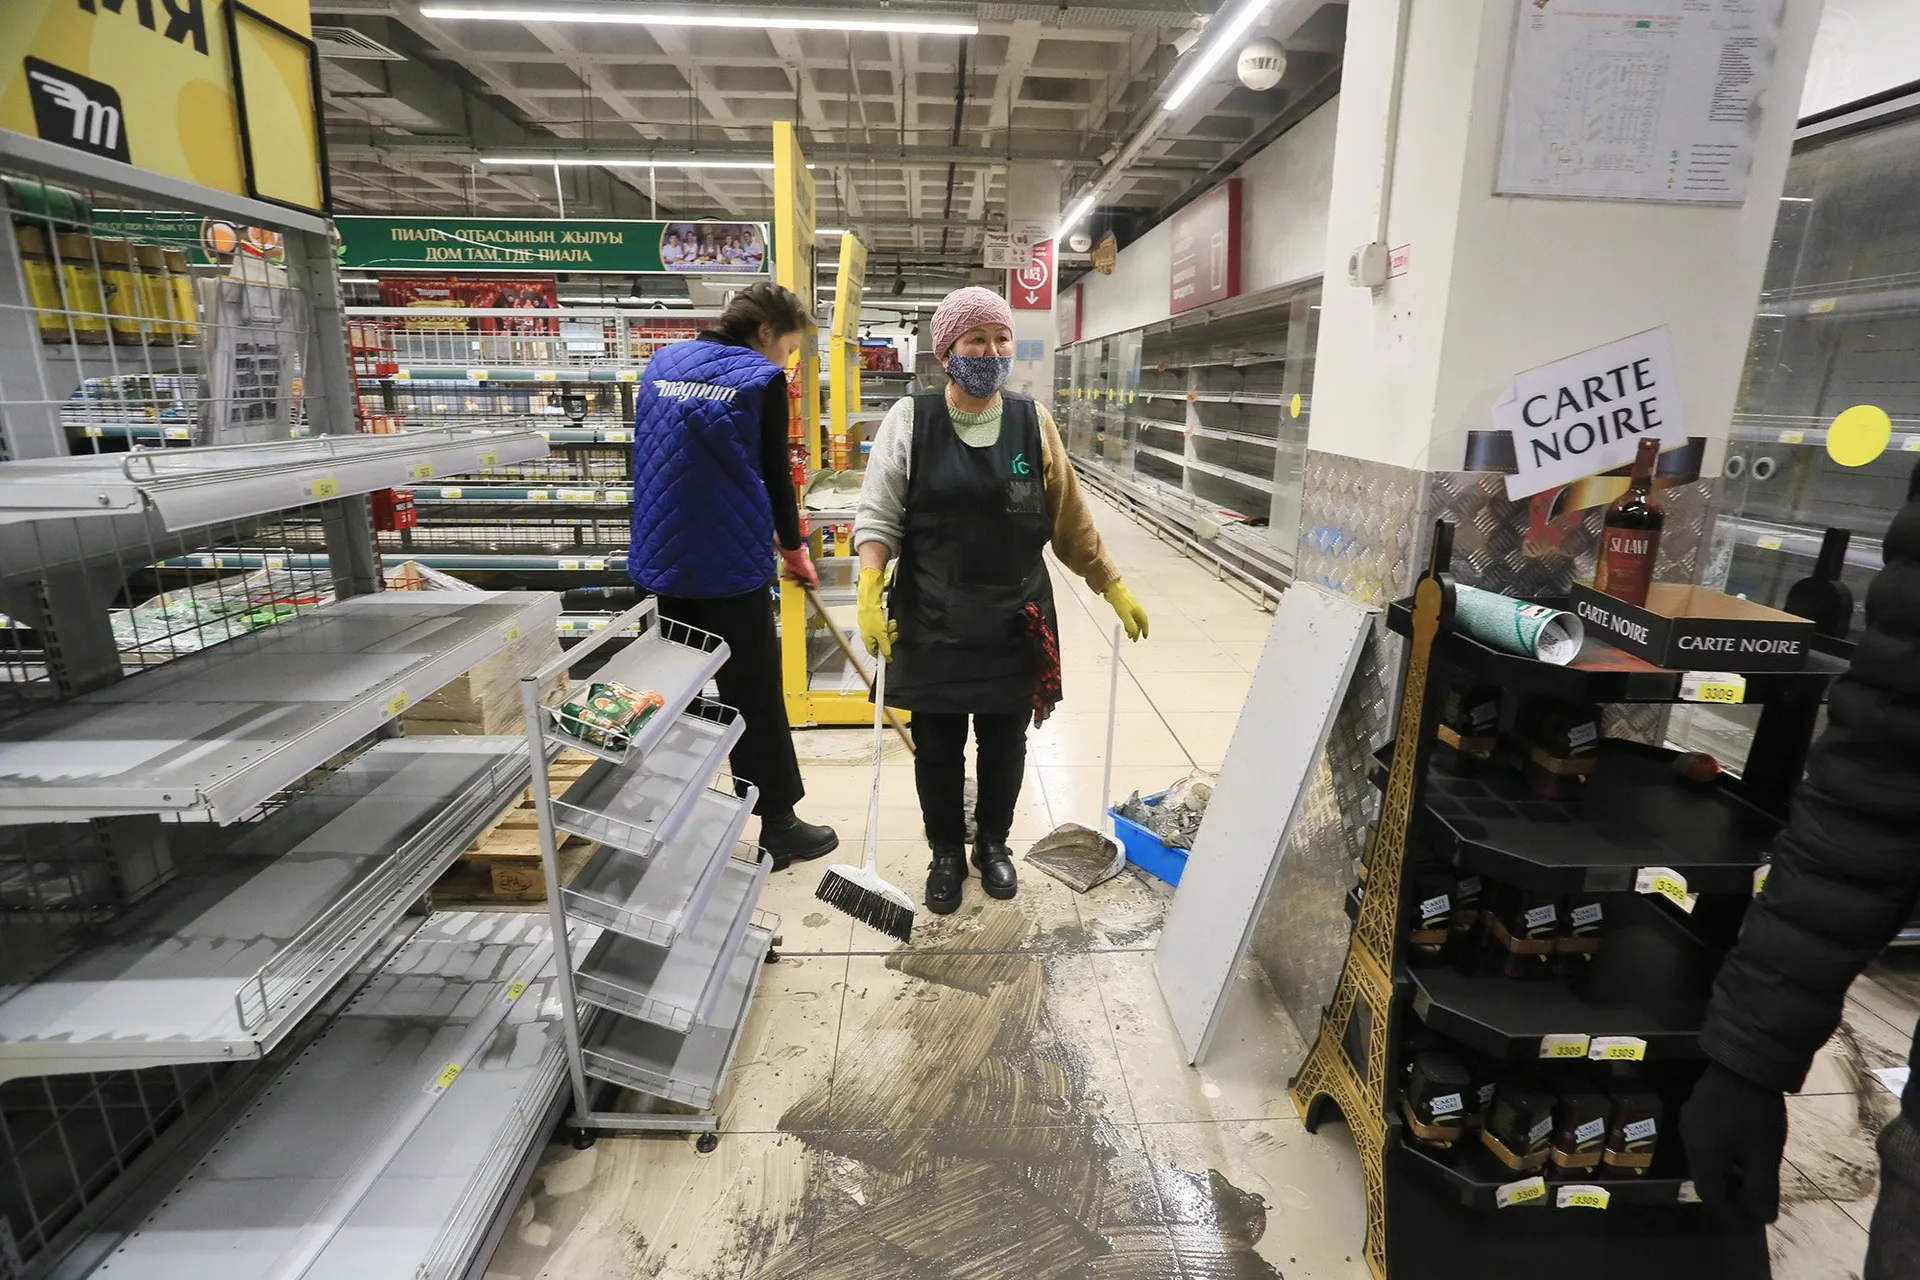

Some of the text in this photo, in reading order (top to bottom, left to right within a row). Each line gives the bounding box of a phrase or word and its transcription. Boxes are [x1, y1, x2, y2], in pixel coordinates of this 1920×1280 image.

[391, 228, 447, 242] ПИАЛА
[560, 230, 624, 244] ЖЫЛУЫ
[425, 247, 462, 262] ДОМ
[505, 249, 534, 263] ГДЕ
[538, 249, 593, 262] ПИАЛА
[652, 379, 737, 403] magnum
[1522, 357, 1656, 428] CARTE
[1529, 397, 1663, 468] NOIRE
[1577, 600, 1650, 646] CARTE NOIRE
[1677, 636, 1801, 655] CARTE NOIRE
[1704, 687, 1734, 701] 3309
[1657, 880, 1685, 900] 3309
[1557, 1046, 1581, 1056] 3309
[1610, 1048, 1635, 1058] 3309
[1434, 1096, 1457, 1107] CARTE
[1436, 1102, 1459, 1112] NOIRE
[1516, 1187, 1539, 1201] 3309
[1574, 1195, 1600, 1206] 3309
